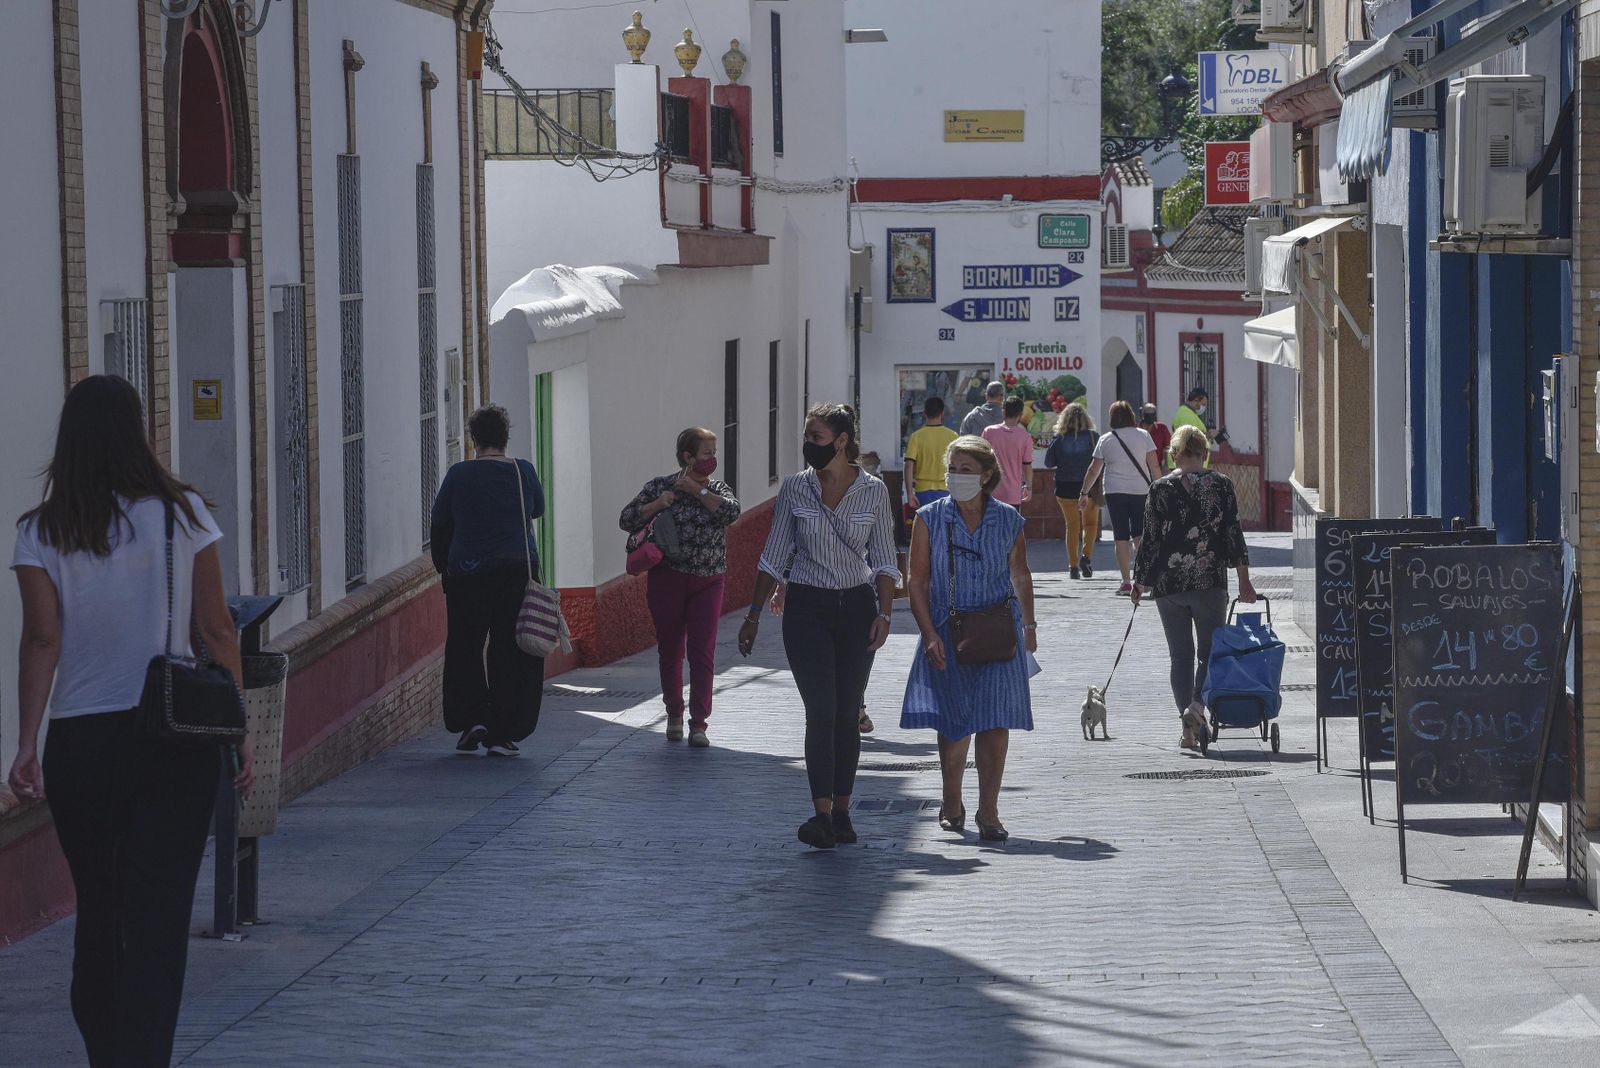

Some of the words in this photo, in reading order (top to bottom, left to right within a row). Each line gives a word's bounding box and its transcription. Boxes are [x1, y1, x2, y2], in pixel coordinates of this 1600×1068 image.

[1242, 68, 1282, 84] DBL
[1230, 97, 1244, 105] 954
[1247, 97, 1259, 105] 156
[1042, 235, 1086, 245] Campoamor
[1053, 227, 1075, 236] Clara
[1069, 252, 1083, 262] 2K
[964, 267, 1059, 286] BORMUJOS
[983, 299, 1030, 319] JUAN
[1056, 299, 1079, 319] AZ
[939, 329, 954, 340] 3K
[1018, 342, 1067, 354] Fruteria
[1002, 358, 1012, 371] J.
[1015, 356, 1083, 371] GORDILLO
[1407, 557, 1551, 591] ROBALOS
[1439, 593, 1527, 615] SALVAJES
[1401, 614, 1441, 634] DESDE
[1432, 630, 1477, 671] 14
[1523, 651, 1547, 671] €
